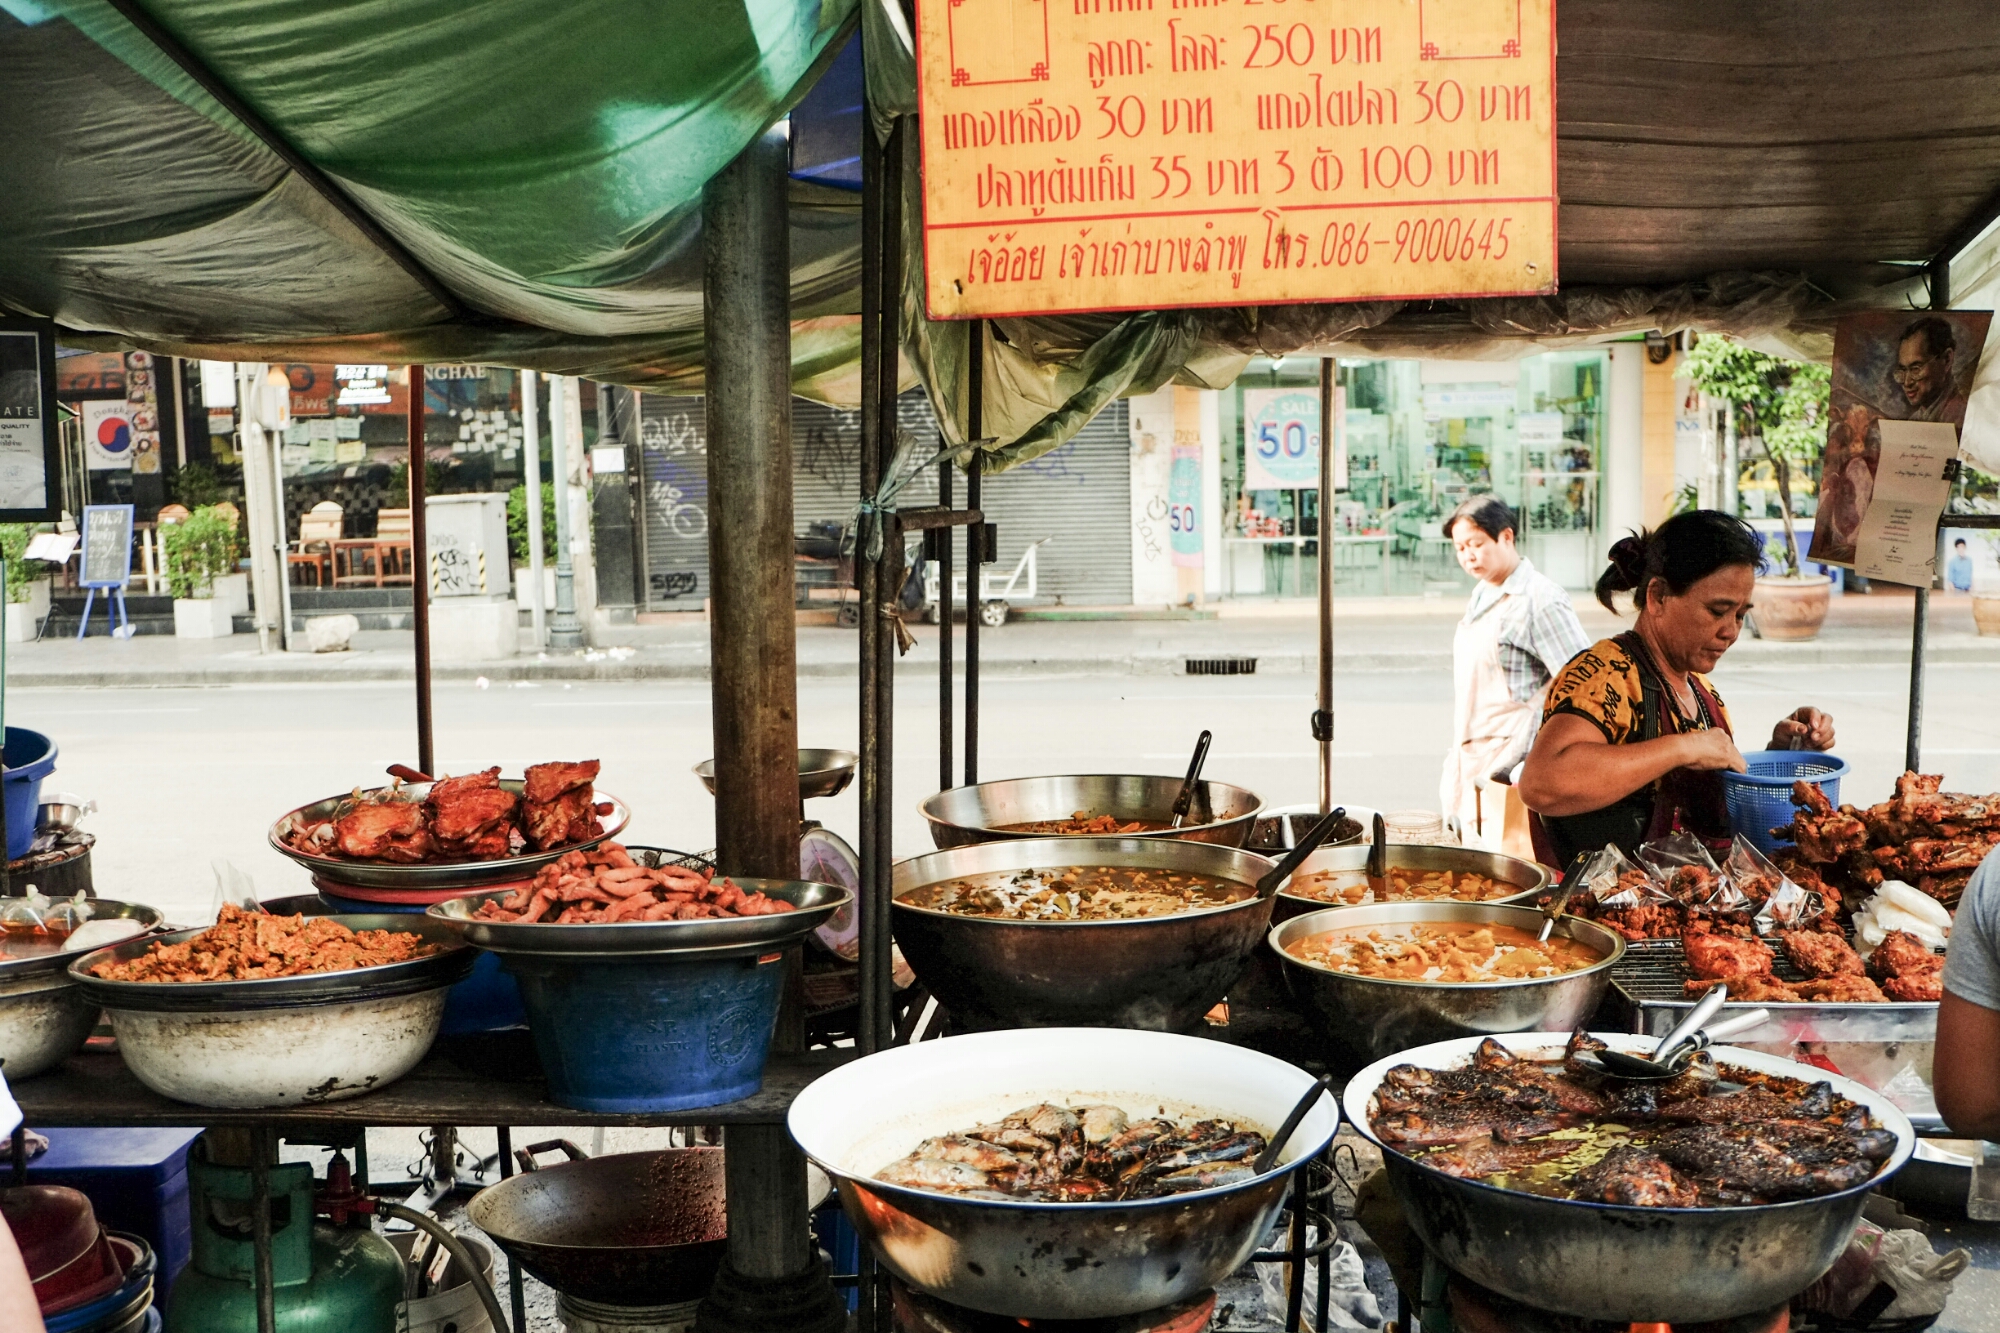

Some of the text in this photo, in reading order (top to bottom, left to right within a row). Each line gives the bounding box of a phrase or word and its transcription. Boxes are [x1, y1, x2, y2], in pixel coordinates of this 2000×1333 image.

[1087, 17, 1383, 89] ลูกกะ โลละ 250 บาท
[943, 73, 1532, 151] แกงเหลือง 30 บาท แกงไตปลา 30 บาท
[976, 144, 1500, 217] ปลาทูต้มเค็ม 35 บาท 3 ตัว 100 บาท
[967, 231, 1046, 285] เจ้อ้อย
[1058, 222, 1248, 290] เจ้าเก่าบางลำพู
[1280, 401, 1316, 416] SALE
[1559, 653, 1606, 695] BERLIN
[634, 1040, 692, 1053] PLASTIC
